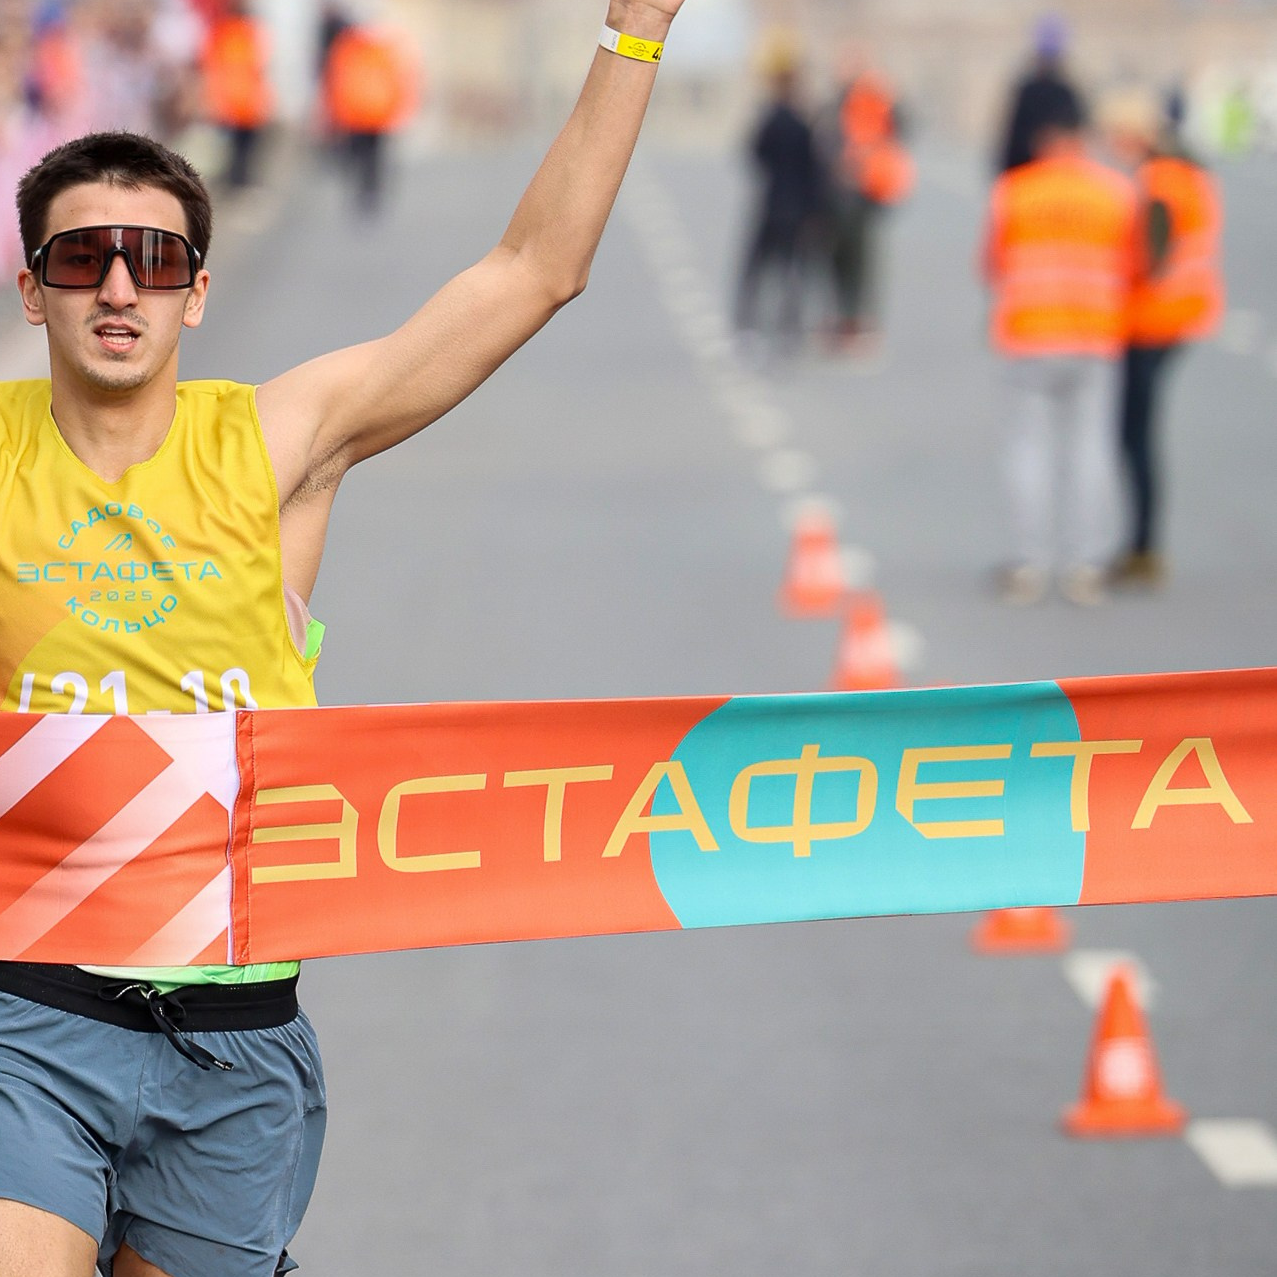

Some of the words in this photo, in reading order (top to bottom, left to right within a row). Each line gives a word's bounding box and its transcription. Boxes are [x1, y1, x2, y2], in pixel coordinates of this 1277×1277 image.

[59, 503, 177, 550] САДОВОЕ
[17, 560, 222, 584] ЭСТАФЕТА
[65, 594, 178, 634] КОЛЬЦО
[90, 590, 153, 603] 2025
[251, 736, 1254, 886] ЭСТАФЕТА
